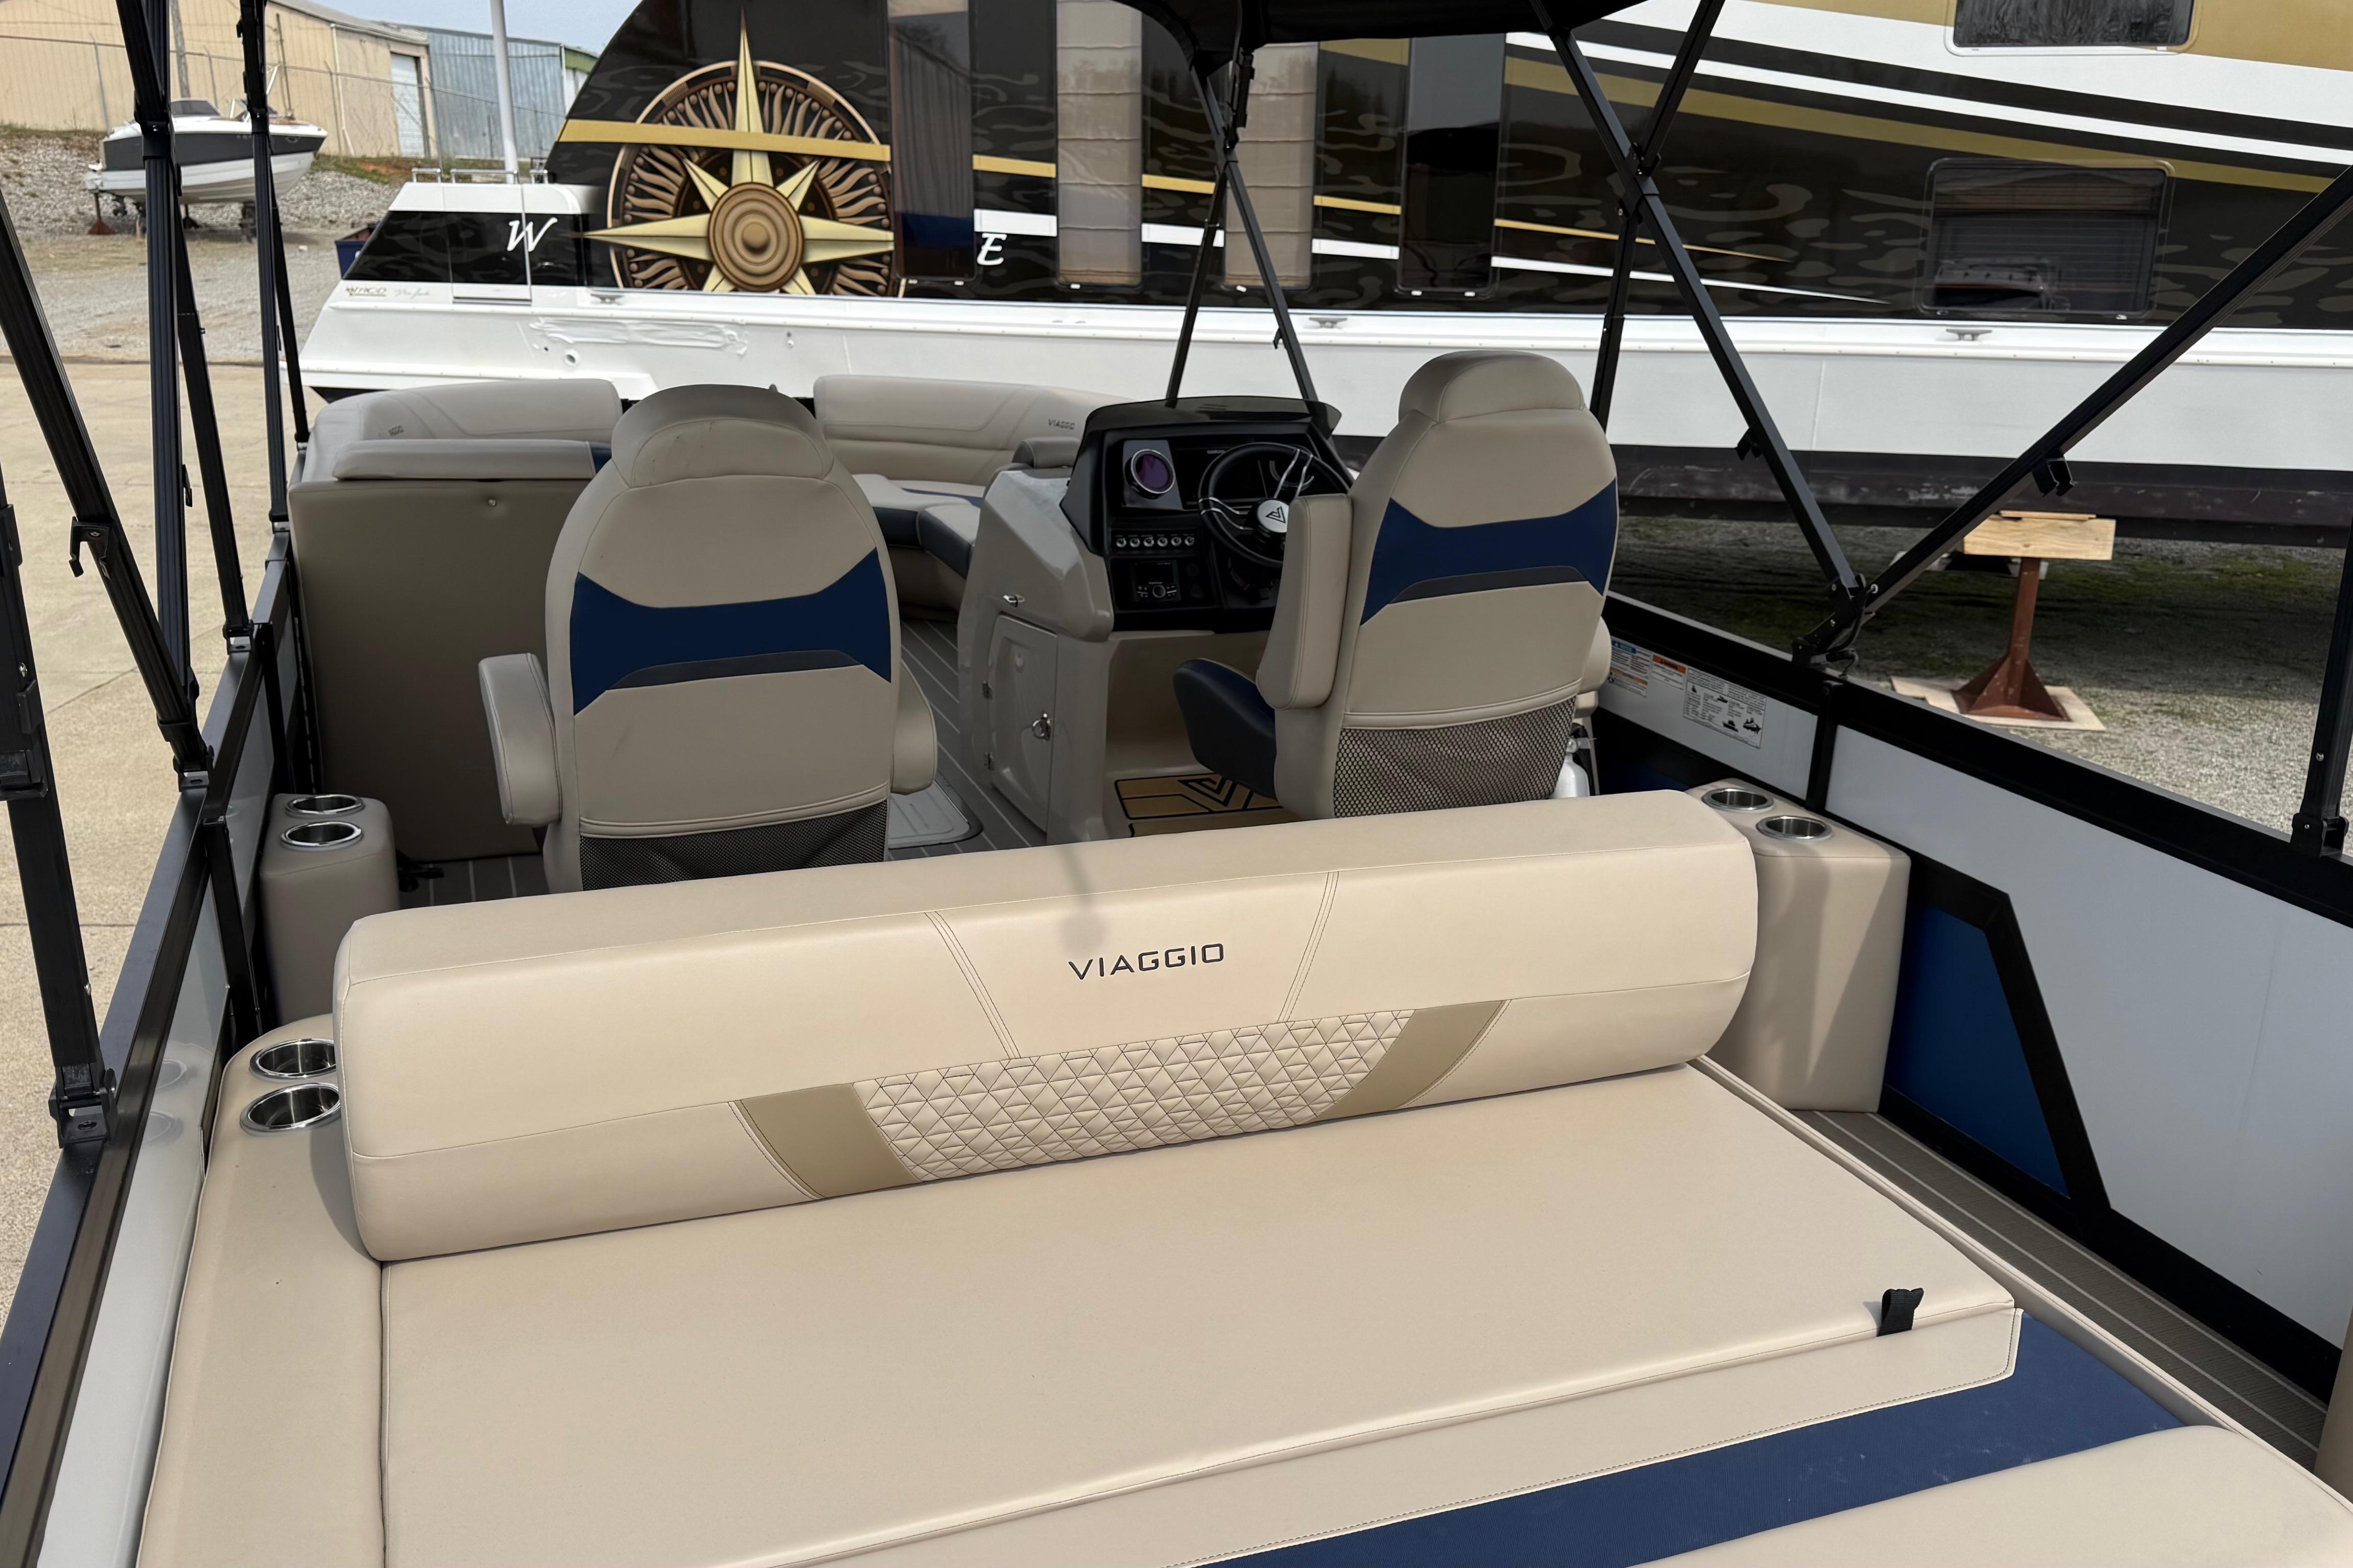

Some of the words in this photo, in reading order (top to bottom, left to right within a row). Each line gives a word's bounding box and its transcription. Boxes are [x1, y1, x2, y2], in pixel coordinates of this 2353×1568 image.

[507, 217, 558, 252] W
[977, 233, 1007, 266] E
[1068, 944, 1224, 980] VIAGGIO
